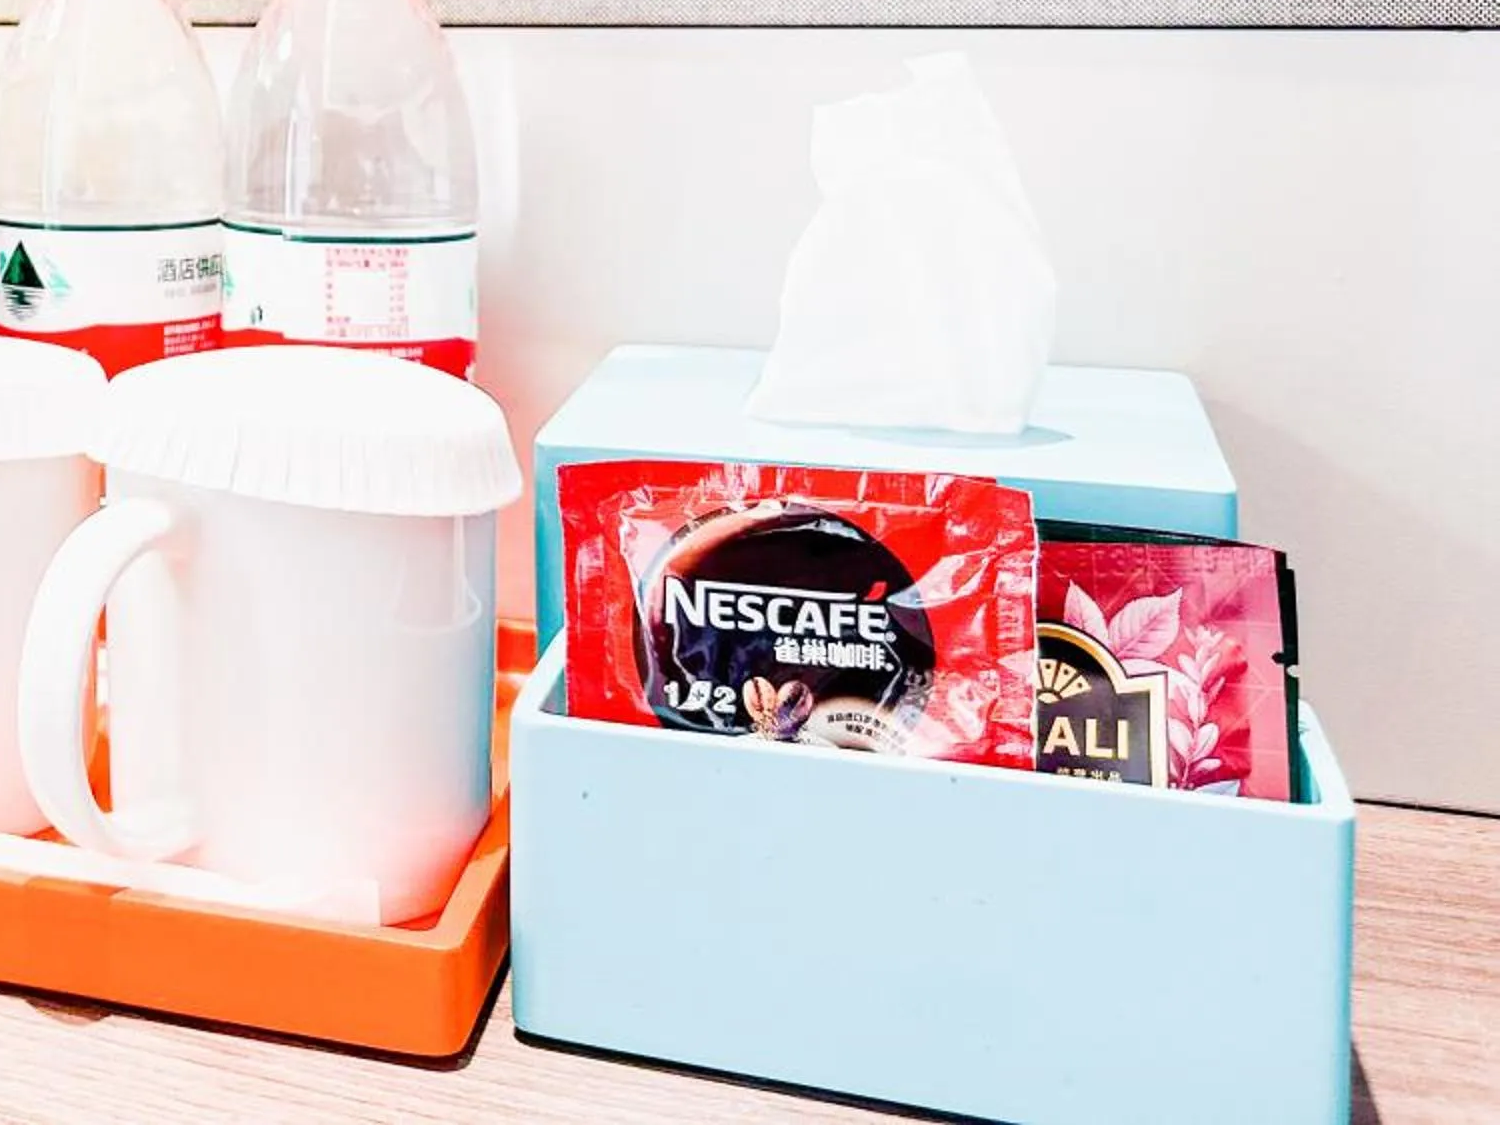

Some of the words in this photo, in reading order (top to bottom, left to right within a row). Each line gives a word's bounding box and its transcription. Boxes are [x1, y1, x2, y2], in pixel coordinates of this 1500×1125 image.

[773, 636, 886, 671] 雀巢咖啡
[1043, 716, 1129, 760] ALI
